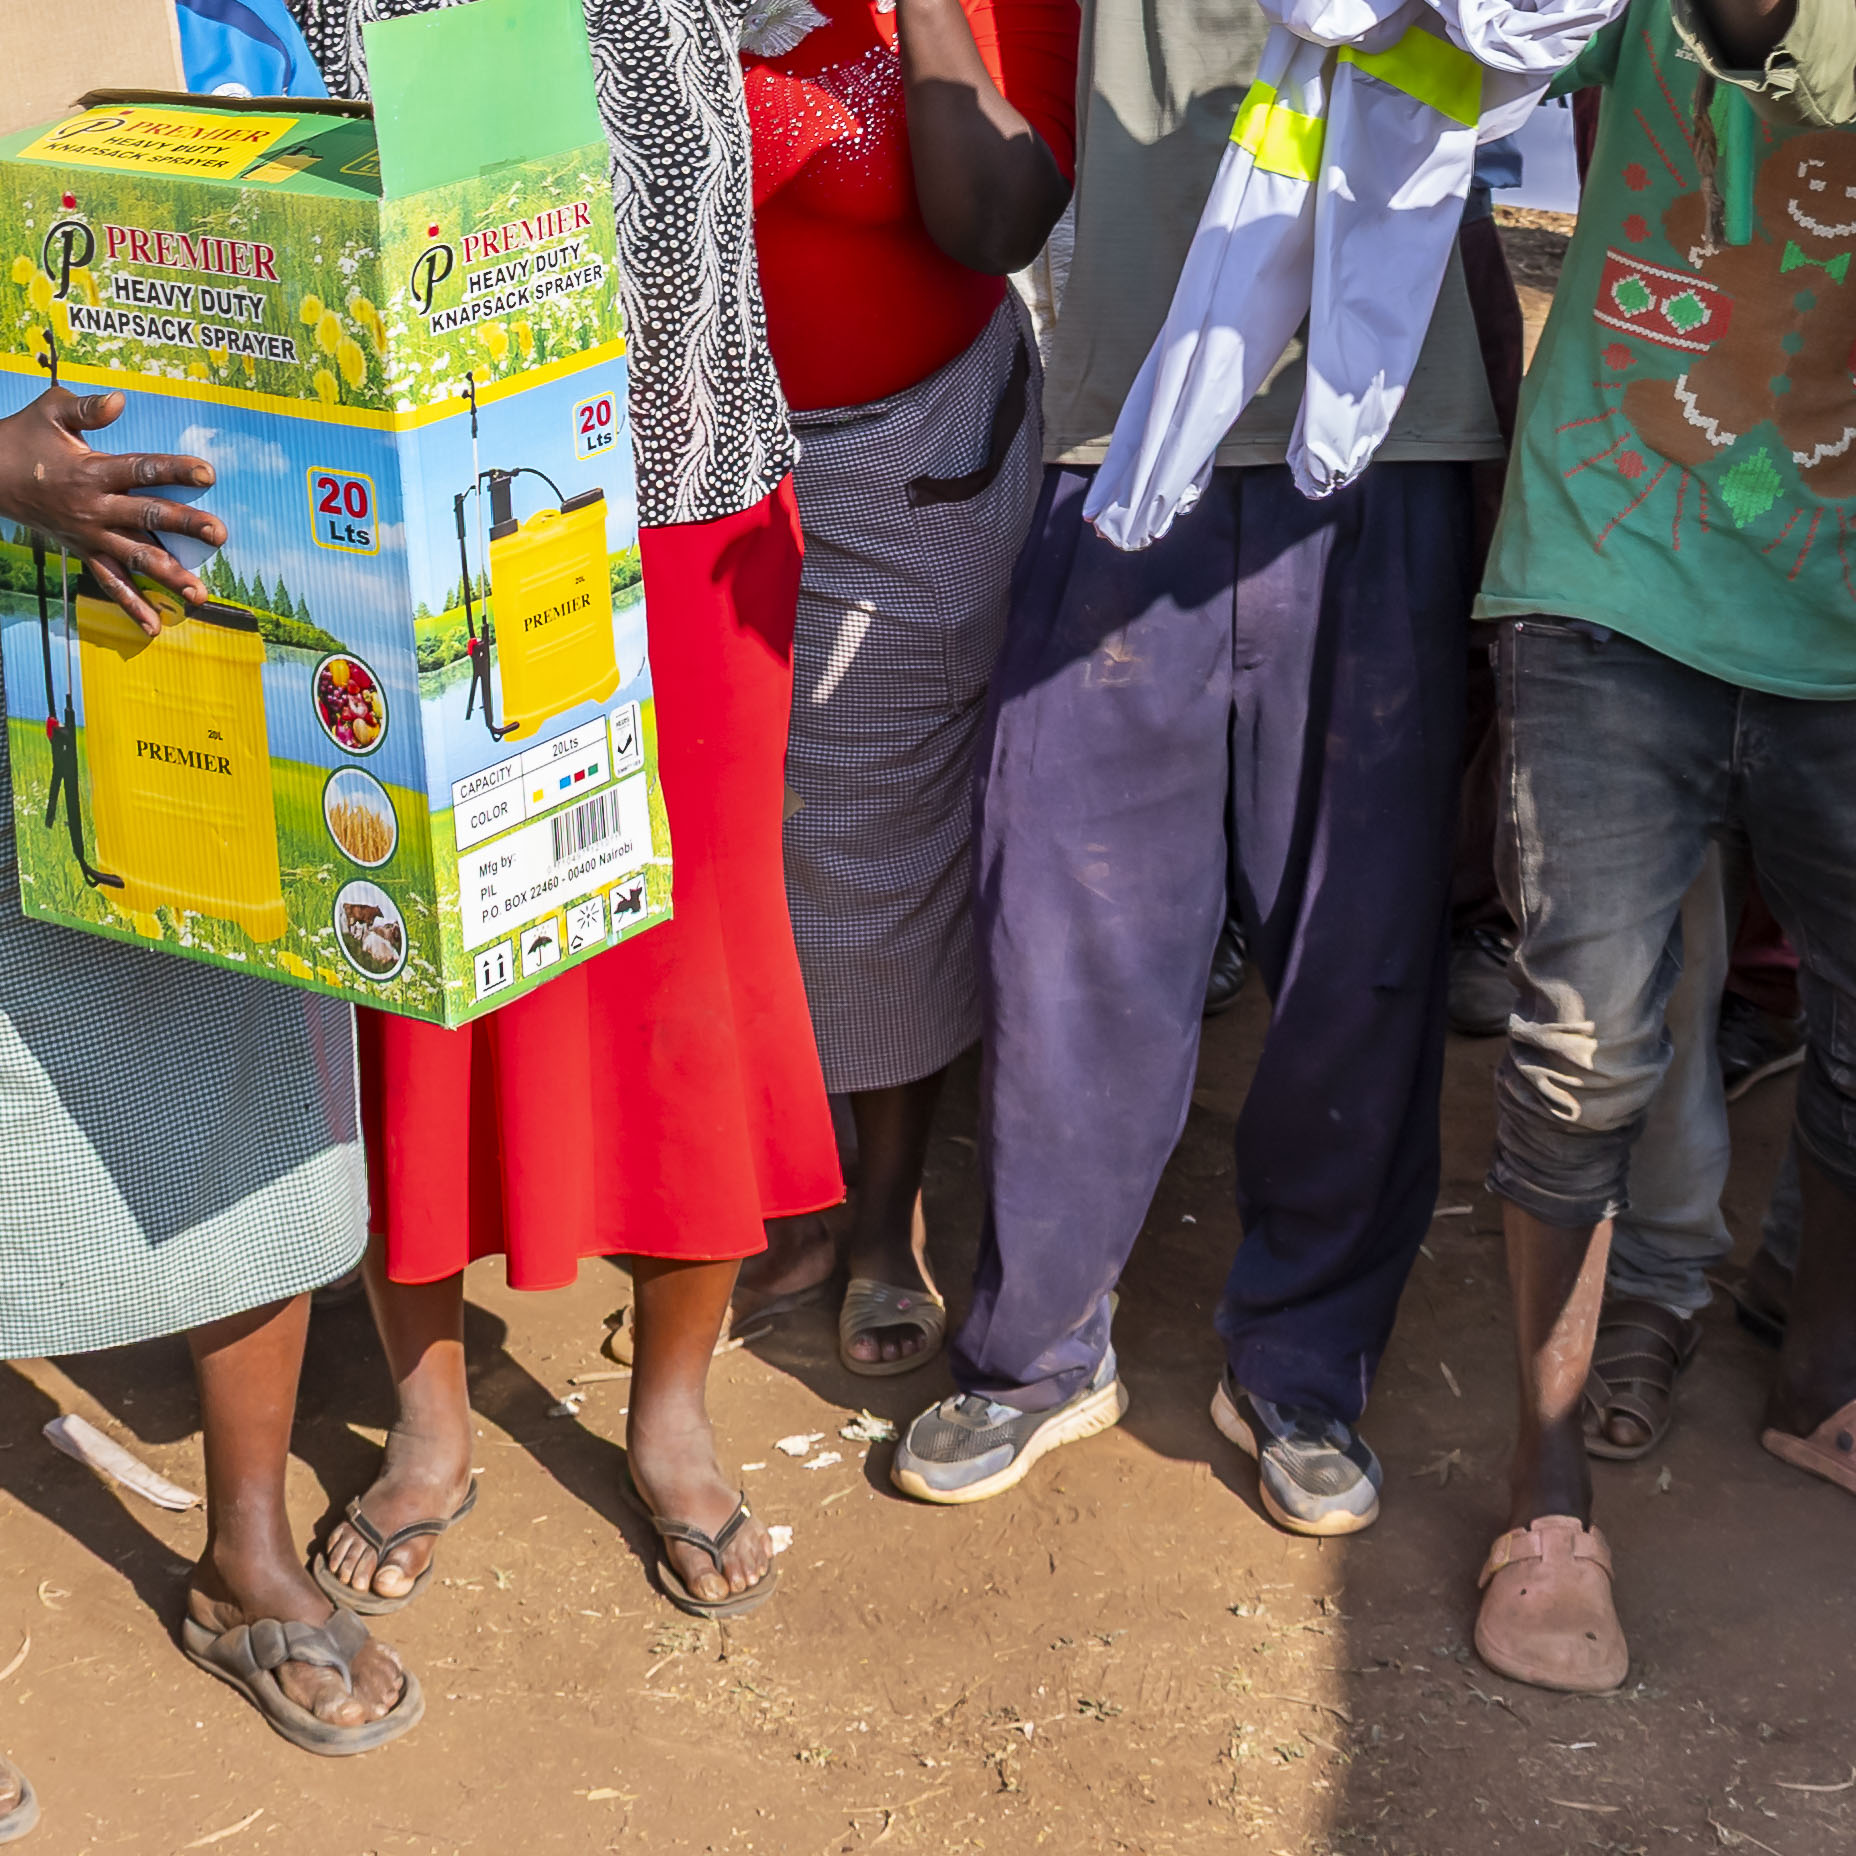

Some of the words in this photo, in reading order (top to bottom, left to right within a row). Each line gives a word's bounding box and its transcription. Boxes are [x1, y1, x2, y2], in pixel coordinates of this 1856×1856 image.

[103, 135, 171, 155] HEAVY
[171, 142, 231, 156] DUTY
[124, 120, 271, 144] PREMIER
[45, 142, 144, 161] KNAPSACK
[147, 154, 230, 170] SPRAYER
[462, 200, 593, 264] PREMIER
[103, 224, 280, 283] PREMIER
[469, 256, 529, 295] HEAVY
[536, 241, 582, 274] DUTY
[114, 275, 194, 311] HEAVY
[200, 287, 265, 322] DUTY
[430, 286, 530, 334] KNAPSACK
[535, 263, 604, 301] SPRAYER
[68, 304, 196, 345] KNAPSACK
[200, 324, 296, 362] SPRAYER
[579, 397, 613, 436] 20
[587, 430, 614, 452] Lts
[316, 475, 369, 521] 20
[329, 519, 372, 547] Lts
[523, 592, 591, 633] PREMIER
[135, 739, 233, 777] PREMIER
[460, 764, 513, 800] CAPACITY
[551, 737, 580, 758] 20Lts
[469, 800, 509, 830] COLOR
[478, 859, 499, 879] Mfg
[504, 891, 529, 914] BOX
[529, 875, 560, 902] 22460
[567, 858, 598, 882] 00400
[598, 839, 634, 868] Nairobi
[479, 883, 498, 902] PIL
